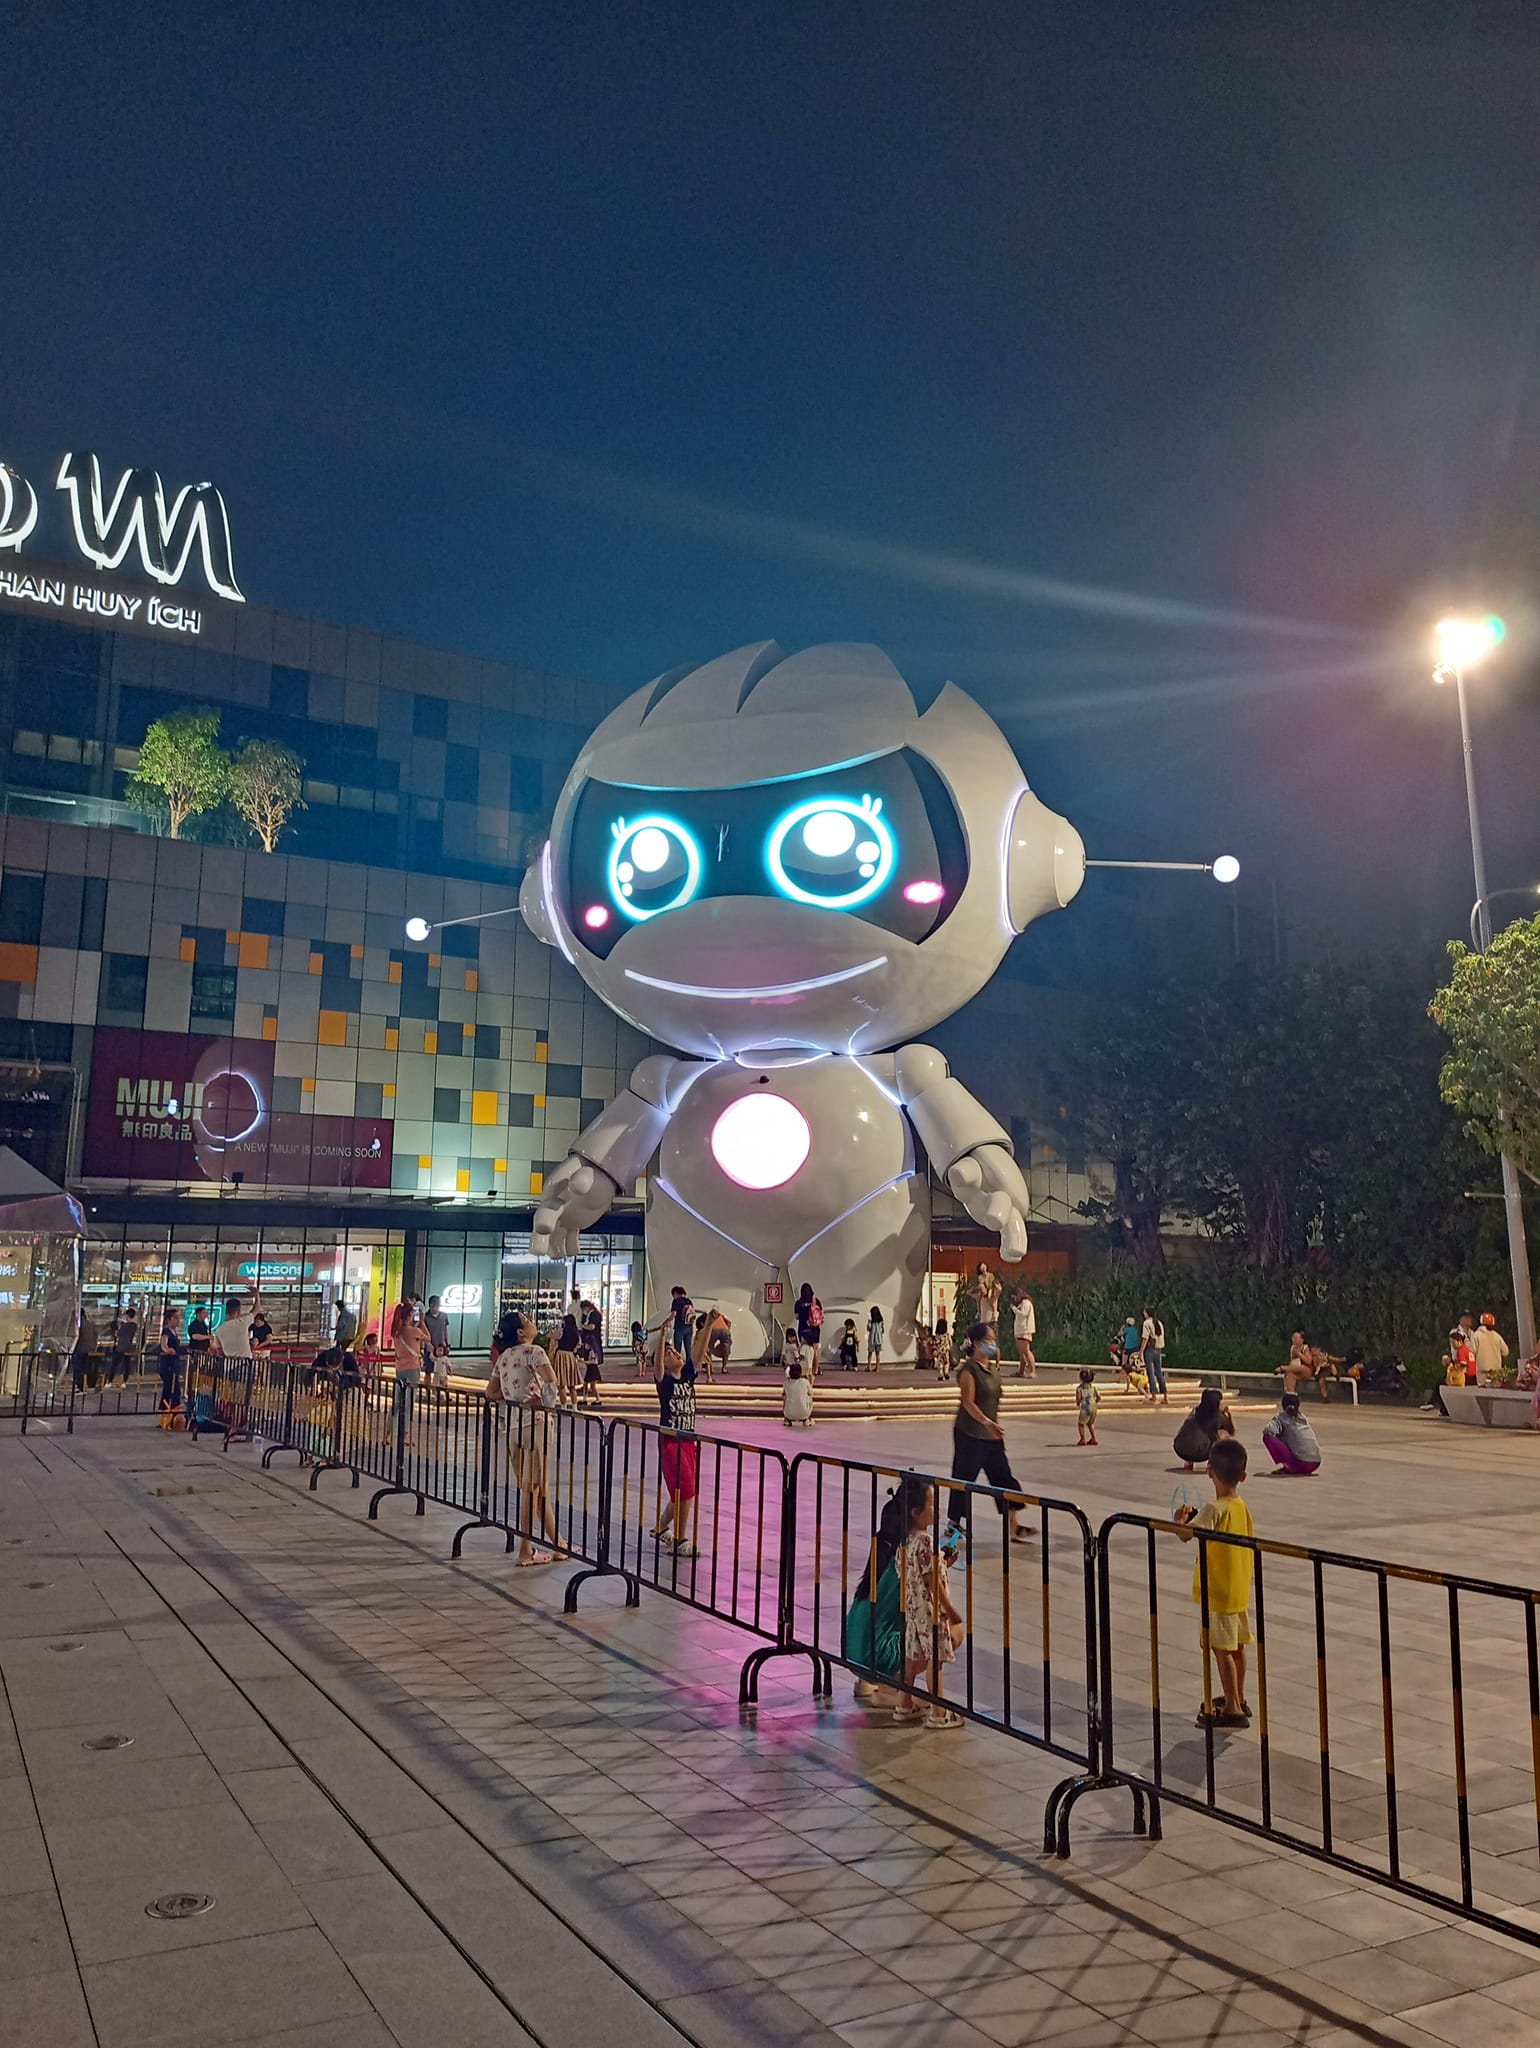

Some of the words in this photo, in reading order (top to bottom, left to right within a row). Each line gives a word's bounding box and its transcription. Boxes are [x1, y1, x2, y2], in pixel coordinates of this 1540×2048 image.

[73, 584, 142, 620] HUY
[148, 596, 201, 634] ÍCH
[115, 1078, 205, 1120] MUJI
[122, 1120, 193, 1140] 無印良品
[234, 1142, 243, 1152] A
[243, 1143, 266, 1153] NEW
[302, 1145, 311, 1155] IS
[313, 1146, 352, 1157] COMING
[354, 1147, 382, 1159] SOON
[245, 1264, 303, 1276] watsons
